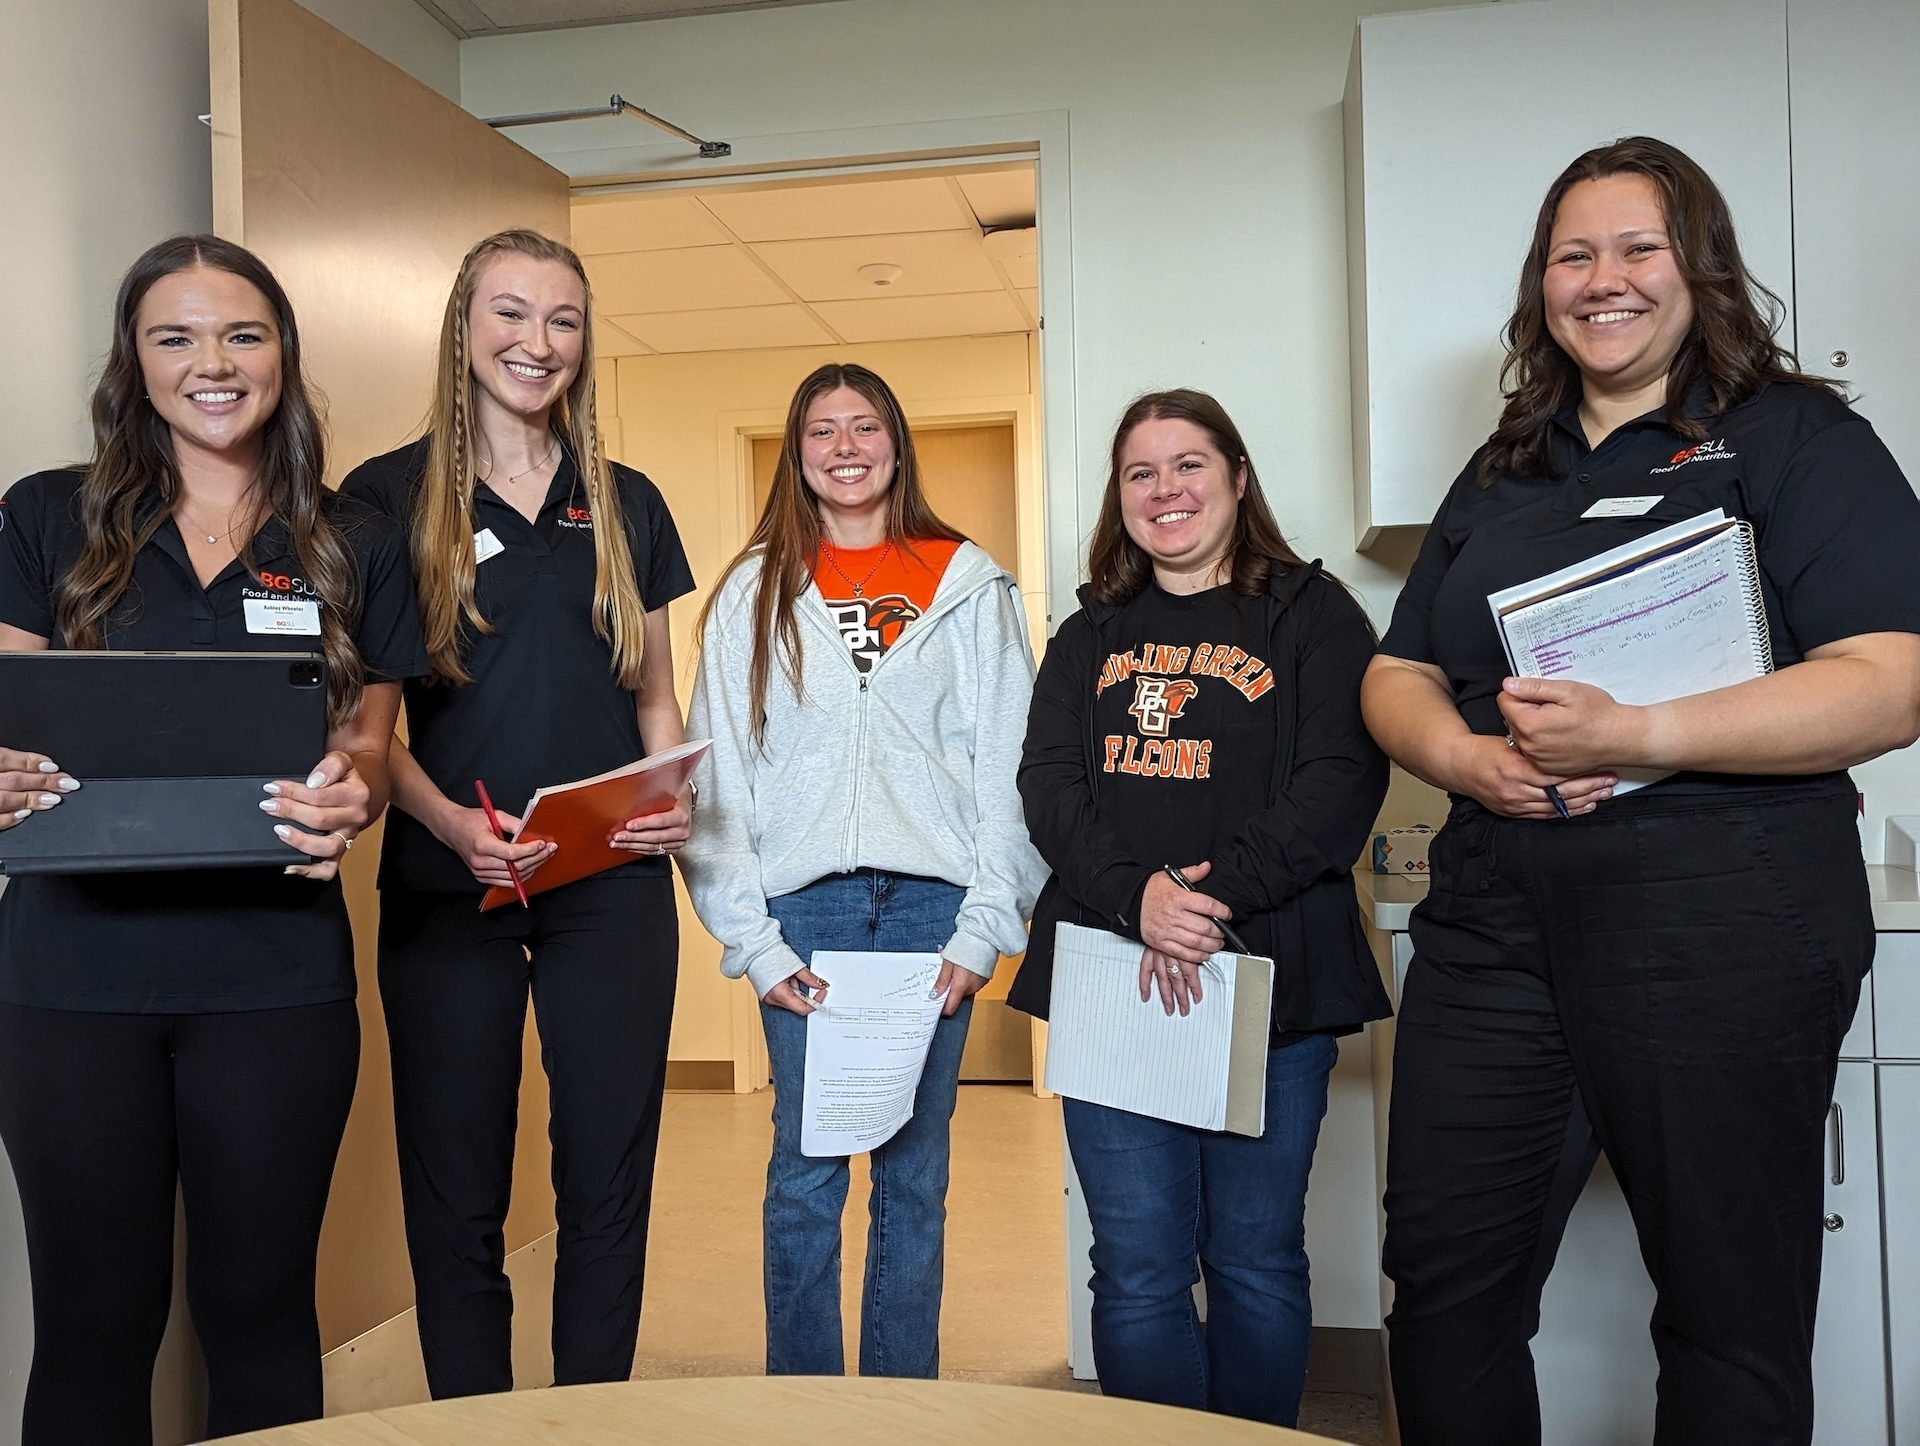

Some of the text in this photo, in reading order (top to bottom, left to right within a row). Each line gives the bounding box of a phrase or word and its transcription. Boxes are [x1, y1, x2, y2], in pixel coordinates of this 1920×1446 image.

[1671, 439, 1725, 463] BGSU
[1650, 465, 1675, 474] Food
[567, 507, 593, 520] BG
[242, 588, 268, 598] Food
[271, 593, 290, 601] and
[260, 572, 317, 595] BGSU
[1190, 643, 1275, 702] GREEN
[1104, 735, 1213, 779] FLCONS
